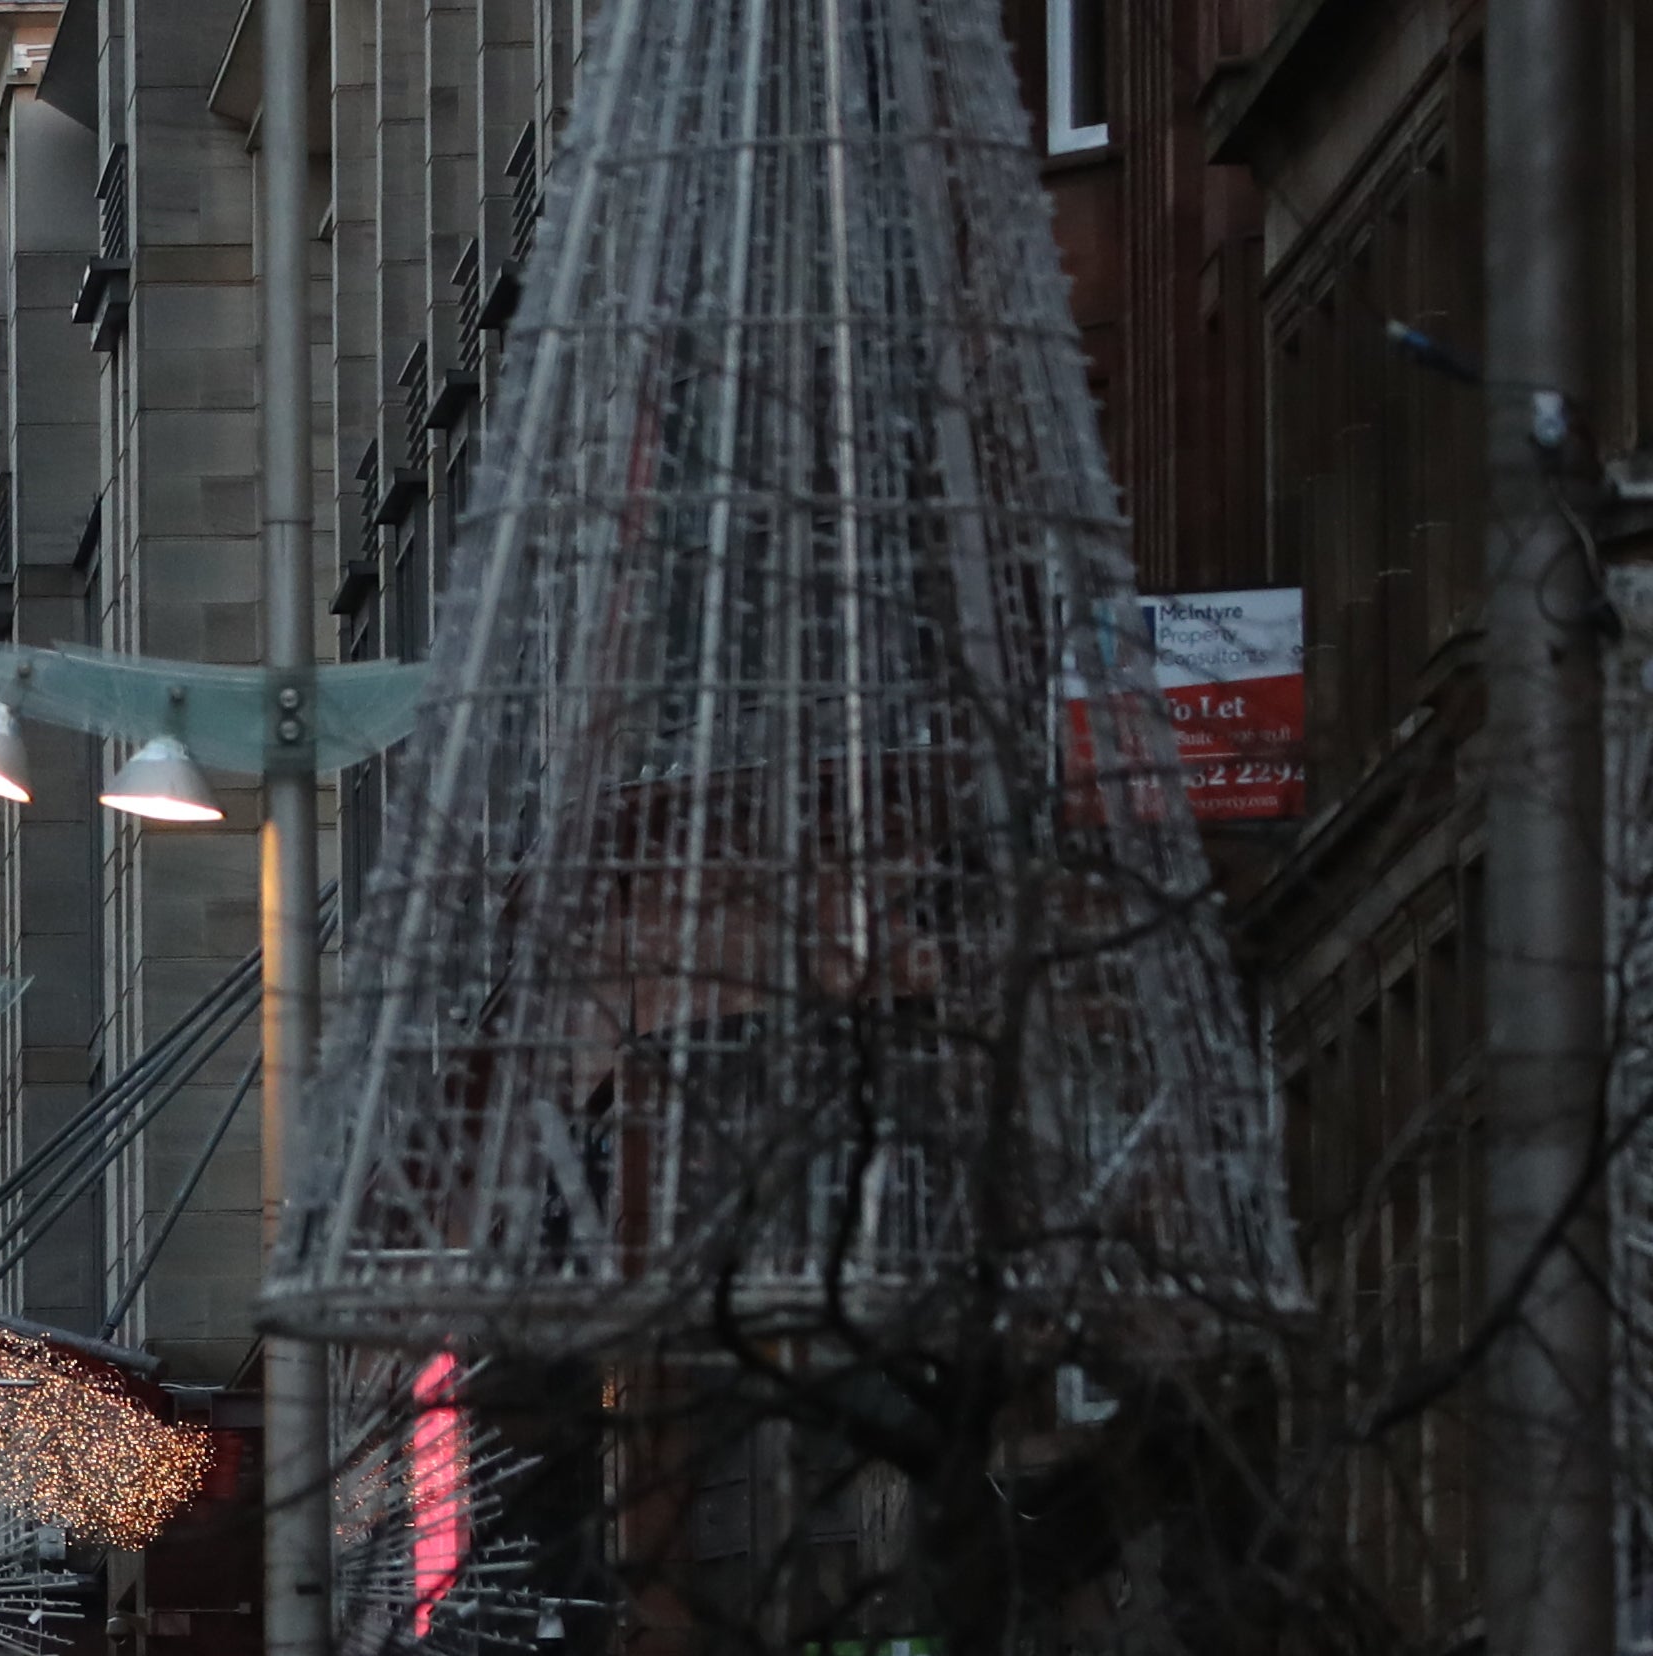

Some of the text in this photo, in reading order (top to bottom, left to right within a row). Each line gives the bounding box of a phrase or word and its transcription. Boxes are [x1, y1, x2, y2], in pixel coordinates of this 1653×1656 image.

[1160, 603, 1243, 624] McIntyre
[1160, 627, 1238, 647] Property
[1200, 694, 1246, 719] Let
